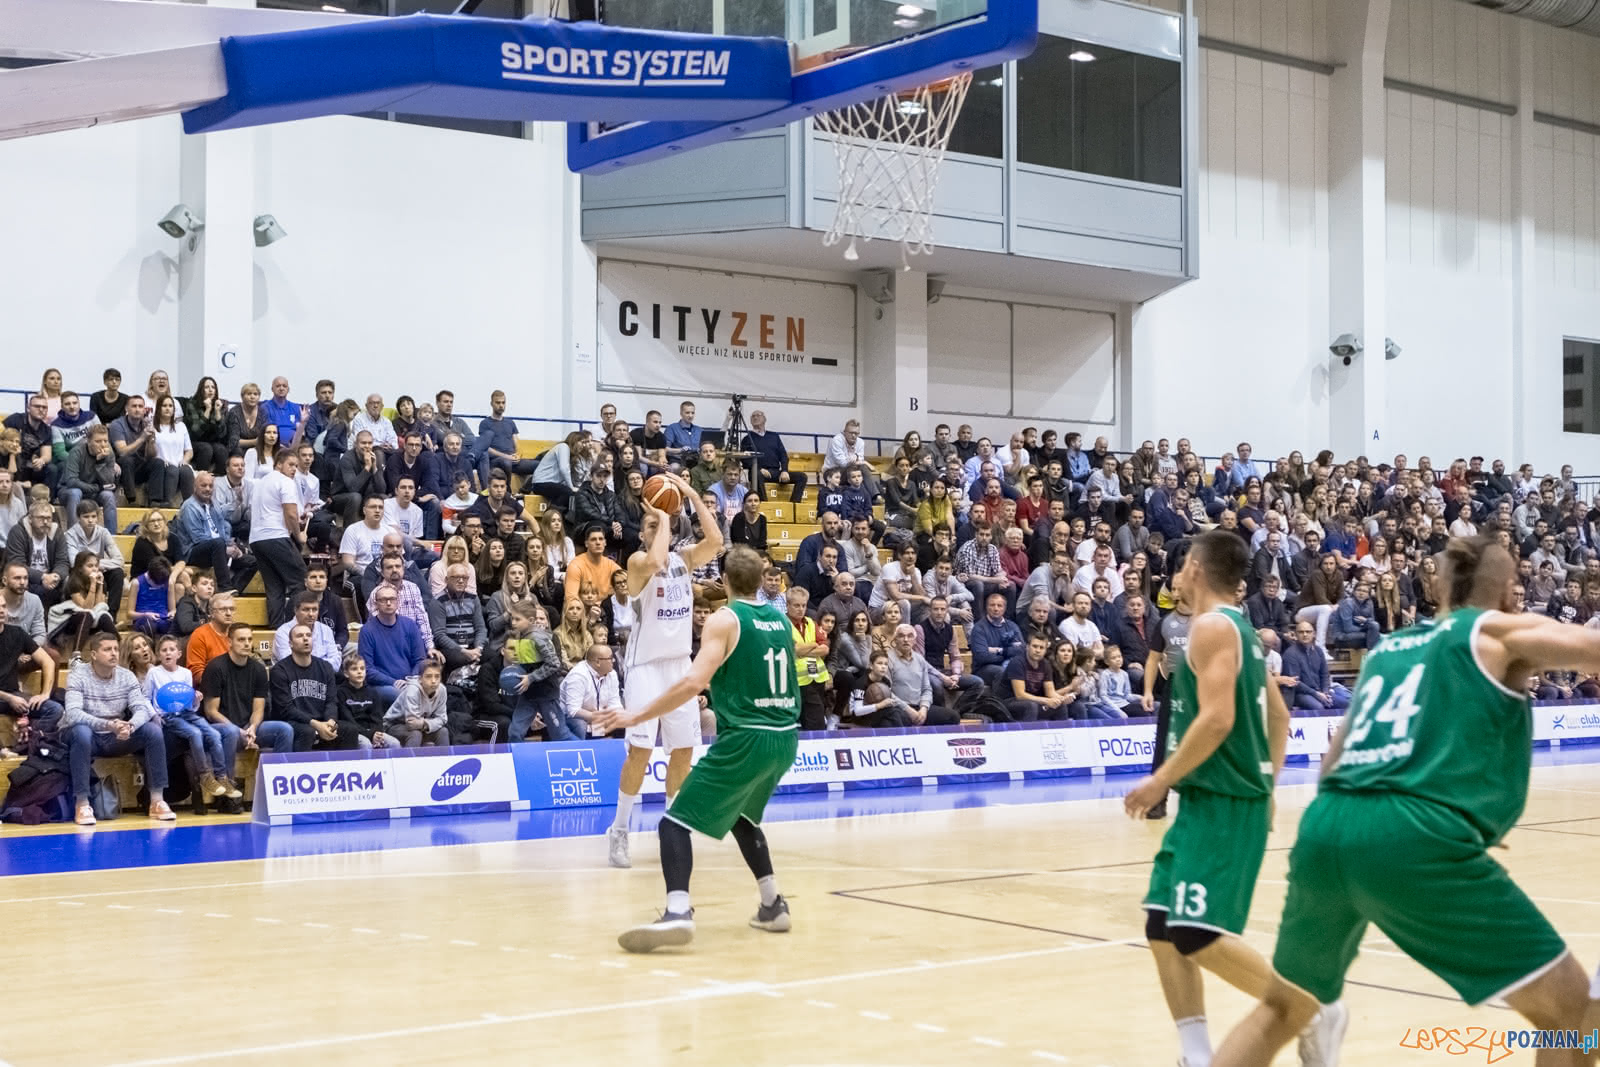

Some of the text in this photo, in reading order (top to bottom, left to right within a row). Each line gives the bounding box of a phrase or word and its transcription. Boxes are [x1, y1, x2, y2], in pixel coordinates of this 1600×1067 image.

[501, 42, 731, 86] SPORT SYSTEM
[618, 300, 805, 353] CITYZEN
[221, 351, 236, 369] C
[678, 344, 710, 357] WIĘCEJ
[732, 349, 755, 360] KLUB
[758, 351, 805, 364] SPORTOWY
[909, 397, 919, 411] B
[1373, 429, 1380, 441] A
[666, 584, 682, 602] 20
[261, 642, 269, 650] 16
[763, 647, 788, 695] 11
[1343, 663, 1425, 749] 24
[858, 747, 922, 768] NICKEL
[954, 747, 983, 757] JOKER
[1043, 751, 1068, 760] HOTEL
[272, 770, 384, 796] BIOFARM
[437, 773, 473, 787] atrem
[551, 781, 601, 797] HOTEL
[311, 795, 351, 803] PRODUCENT
[354, 793, 377, 801] LEKÓW
[553, 795, 602, 806] POZNAŃSKI
[1174, 880, 1208, 917] 13
